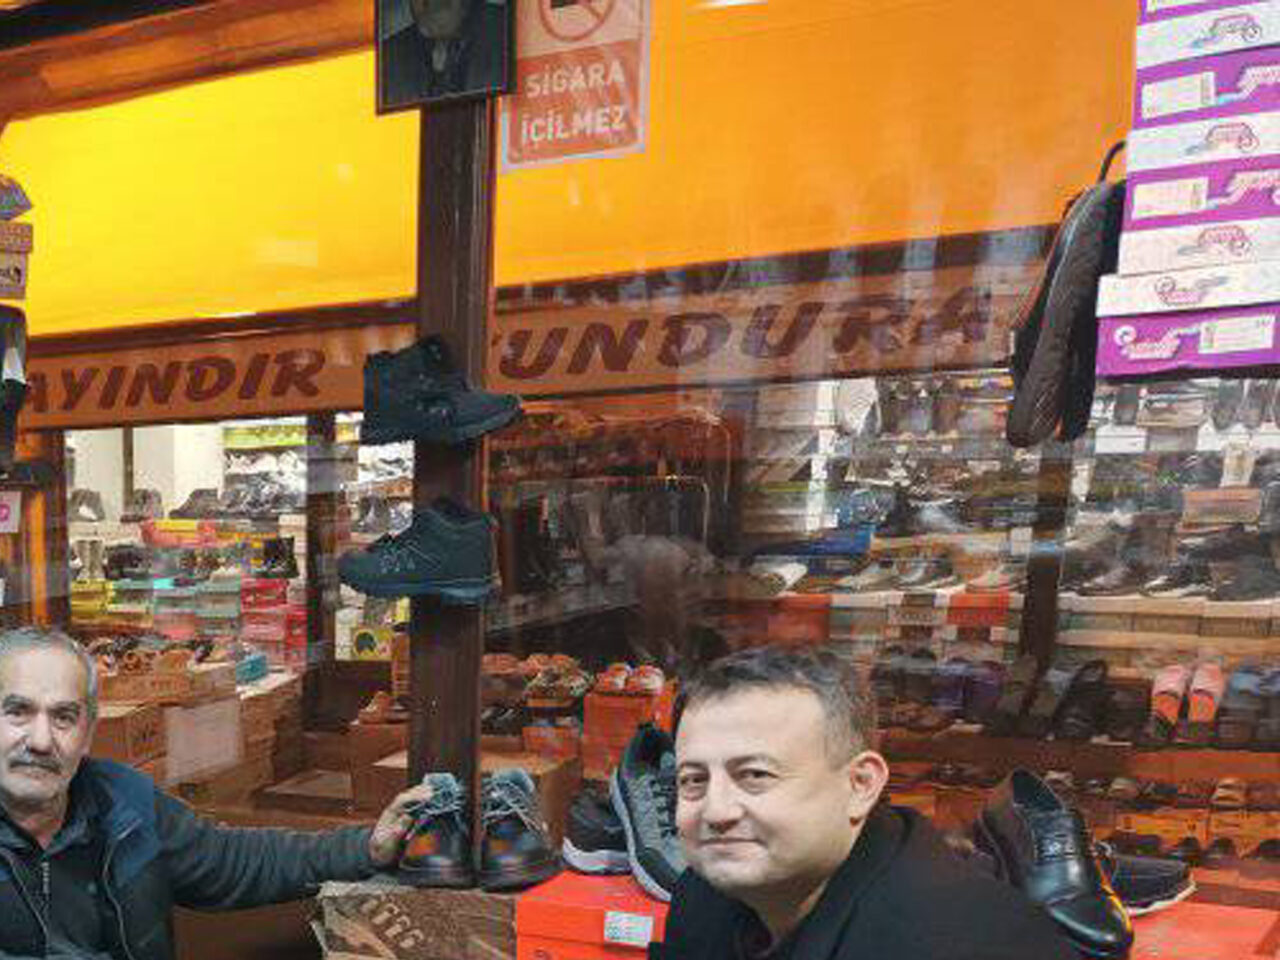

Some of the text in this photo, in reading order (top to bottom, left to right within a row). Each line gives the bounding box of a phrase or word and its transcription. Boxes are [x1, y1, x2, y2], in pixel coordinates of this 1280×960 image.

[524, 59, 625, 98] SİGARA
[521, 103, 627, 147] İÇİLMEZ
[491, 287, 991, 379] UNDURA
